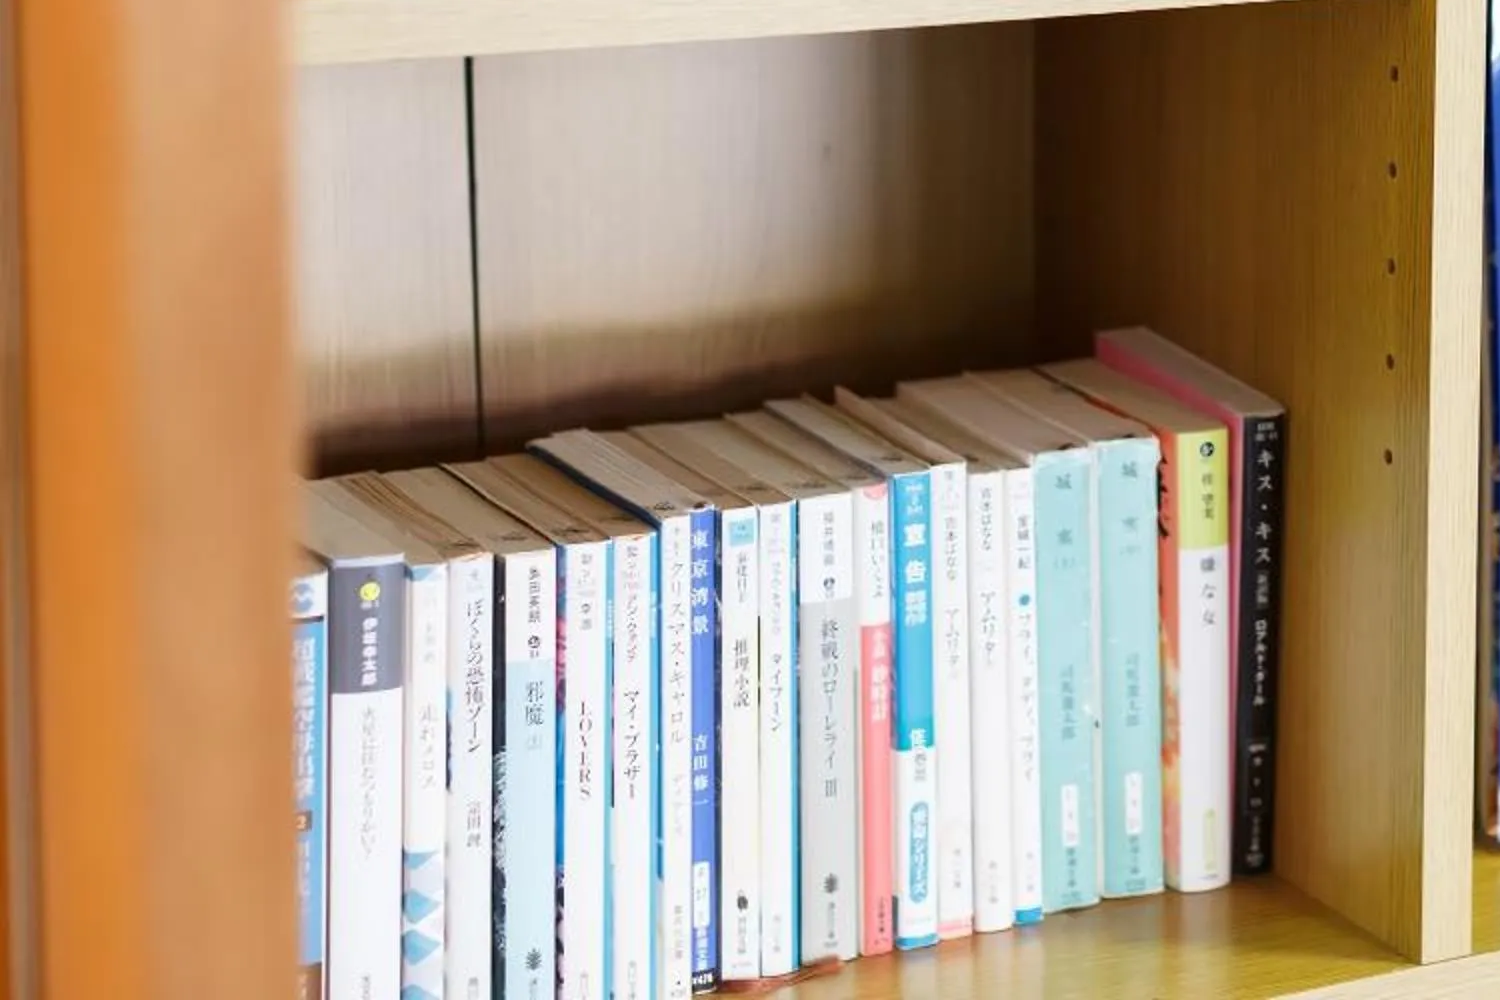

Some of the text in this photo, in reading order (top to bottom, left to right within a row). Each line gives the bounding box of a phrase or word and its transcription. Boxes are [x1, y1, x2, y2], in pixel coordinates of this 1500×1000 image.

[1255, 449, 1275, 564] キス・キス
[690, 529, 710, 635] 東京湾景
[526, 680, 544, 727] 邪魔
[668, 562, 687, 744] クリスマス・キャロル
[733, 638, 751, 710] 推理小説
[578, 701, 593, 801] LOVERS
[622, 689, 641, 799] マイ・ブラザー
[693, 733, 710, 806] 吉田修一
